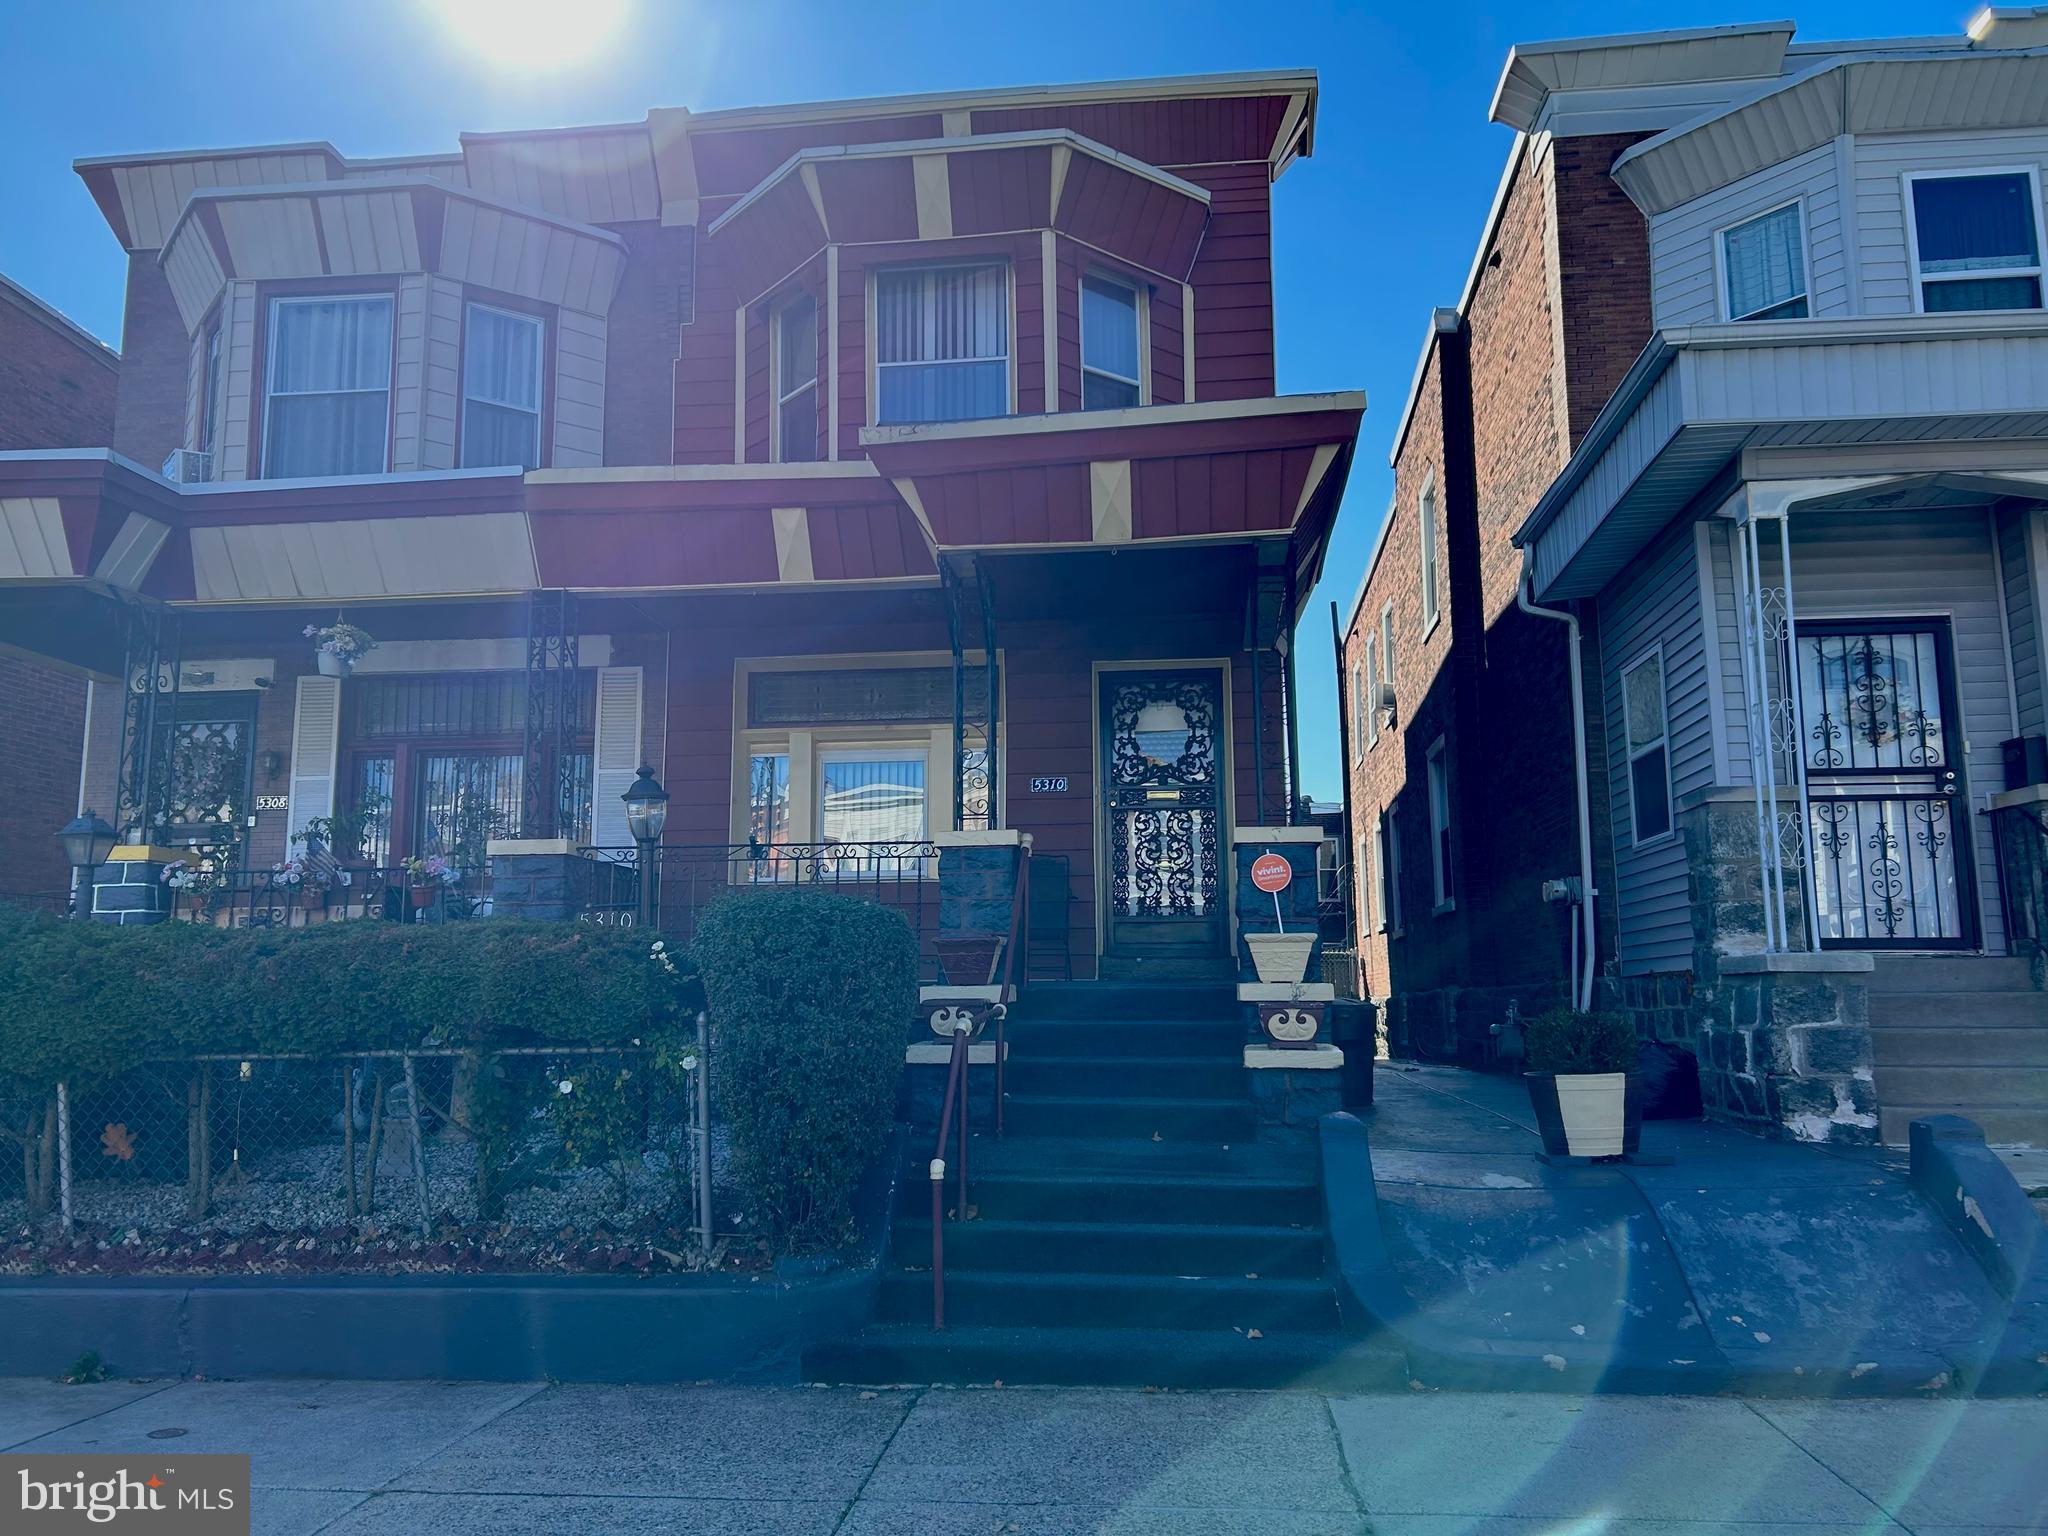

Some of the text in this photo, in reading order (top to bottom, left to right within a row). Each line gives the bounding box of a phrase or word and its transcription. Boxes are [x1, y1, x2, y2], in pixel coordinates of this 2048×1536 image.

[1034, 779, 1065, 790] 5310
[258, 797, 286, 808] 5308
[580, 911, 632, 928] 5310
